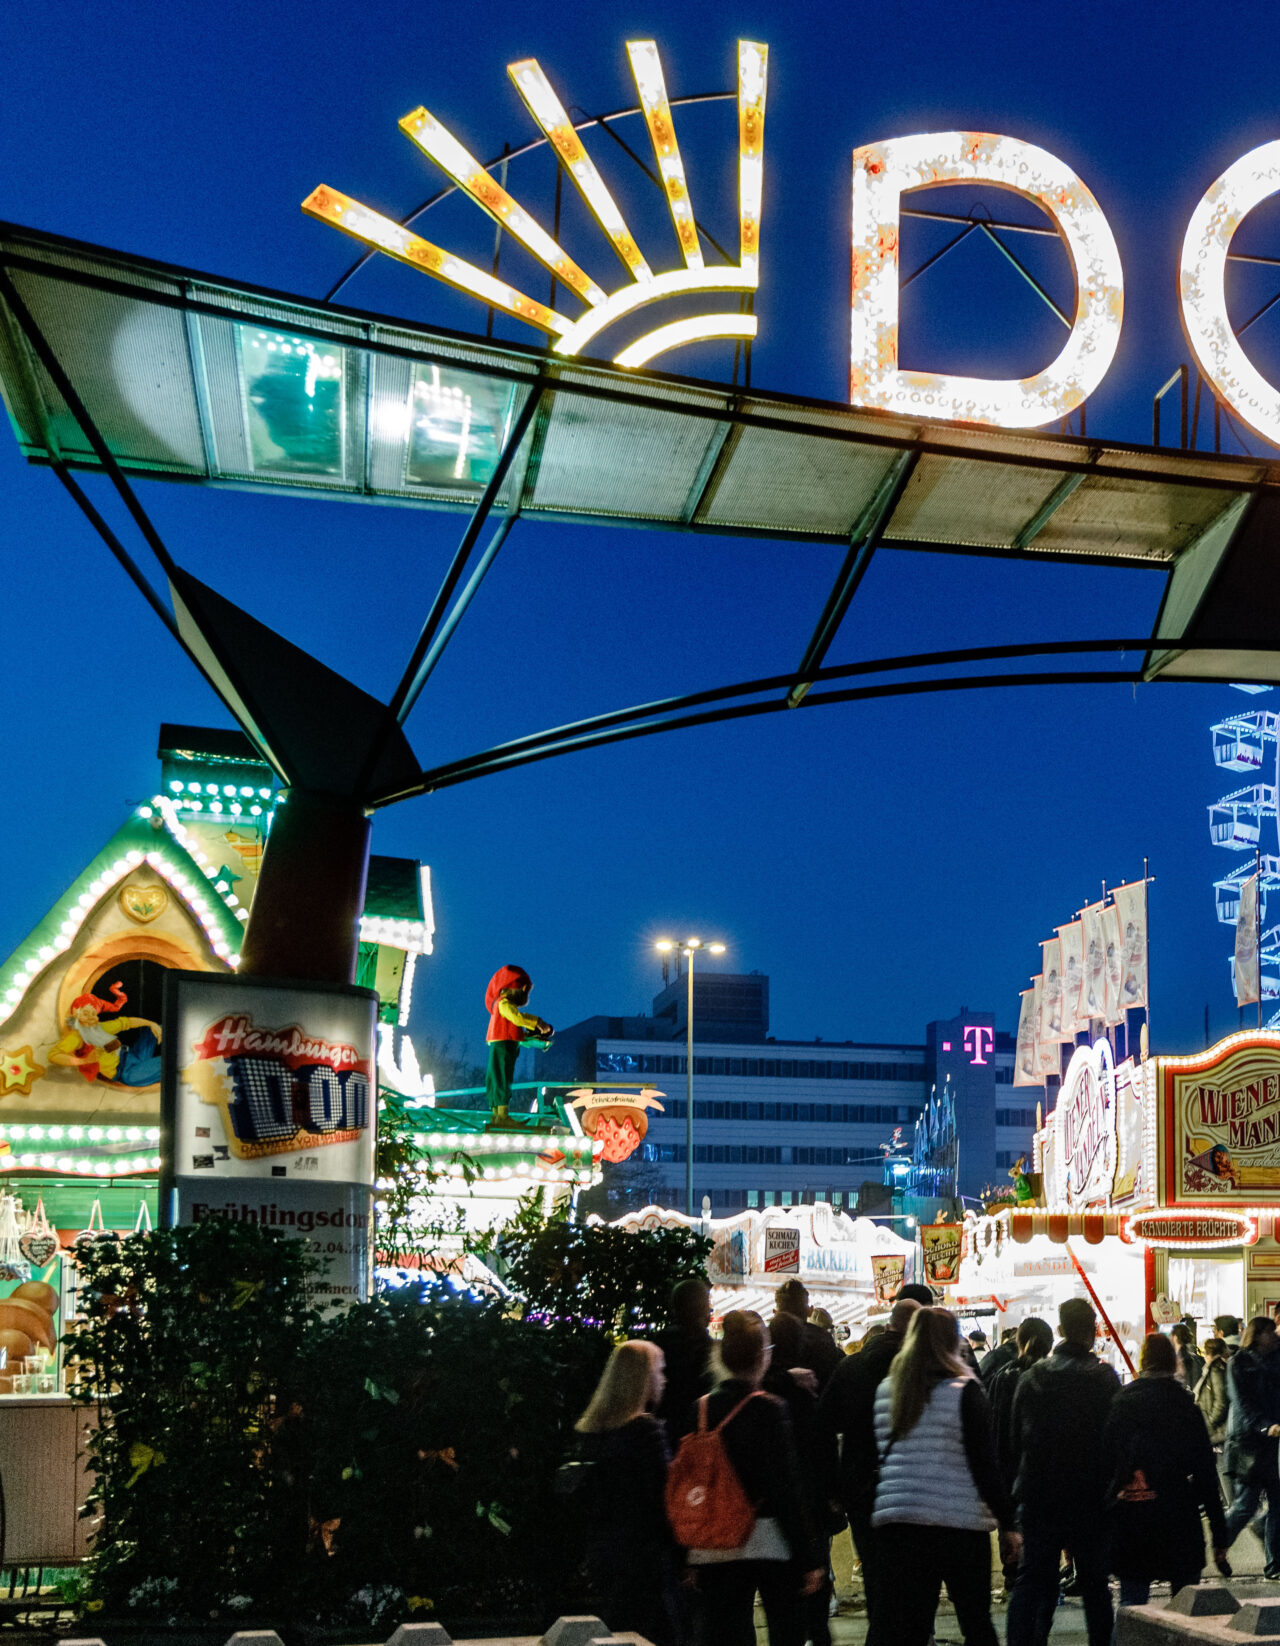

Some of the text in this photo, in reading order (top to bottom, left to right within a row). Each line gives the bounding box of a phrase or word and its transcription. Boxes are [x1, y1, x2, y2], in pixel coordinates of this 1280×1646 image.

[214, 1018, 358, 1068] Hamburger
[768, 1231, 797, 1241] SCHMALZ
[1141, 1219, 1238, 1237] KANDIERTE FRÜCHTE
[924, 1241, 958, 1255] SCHOKO
